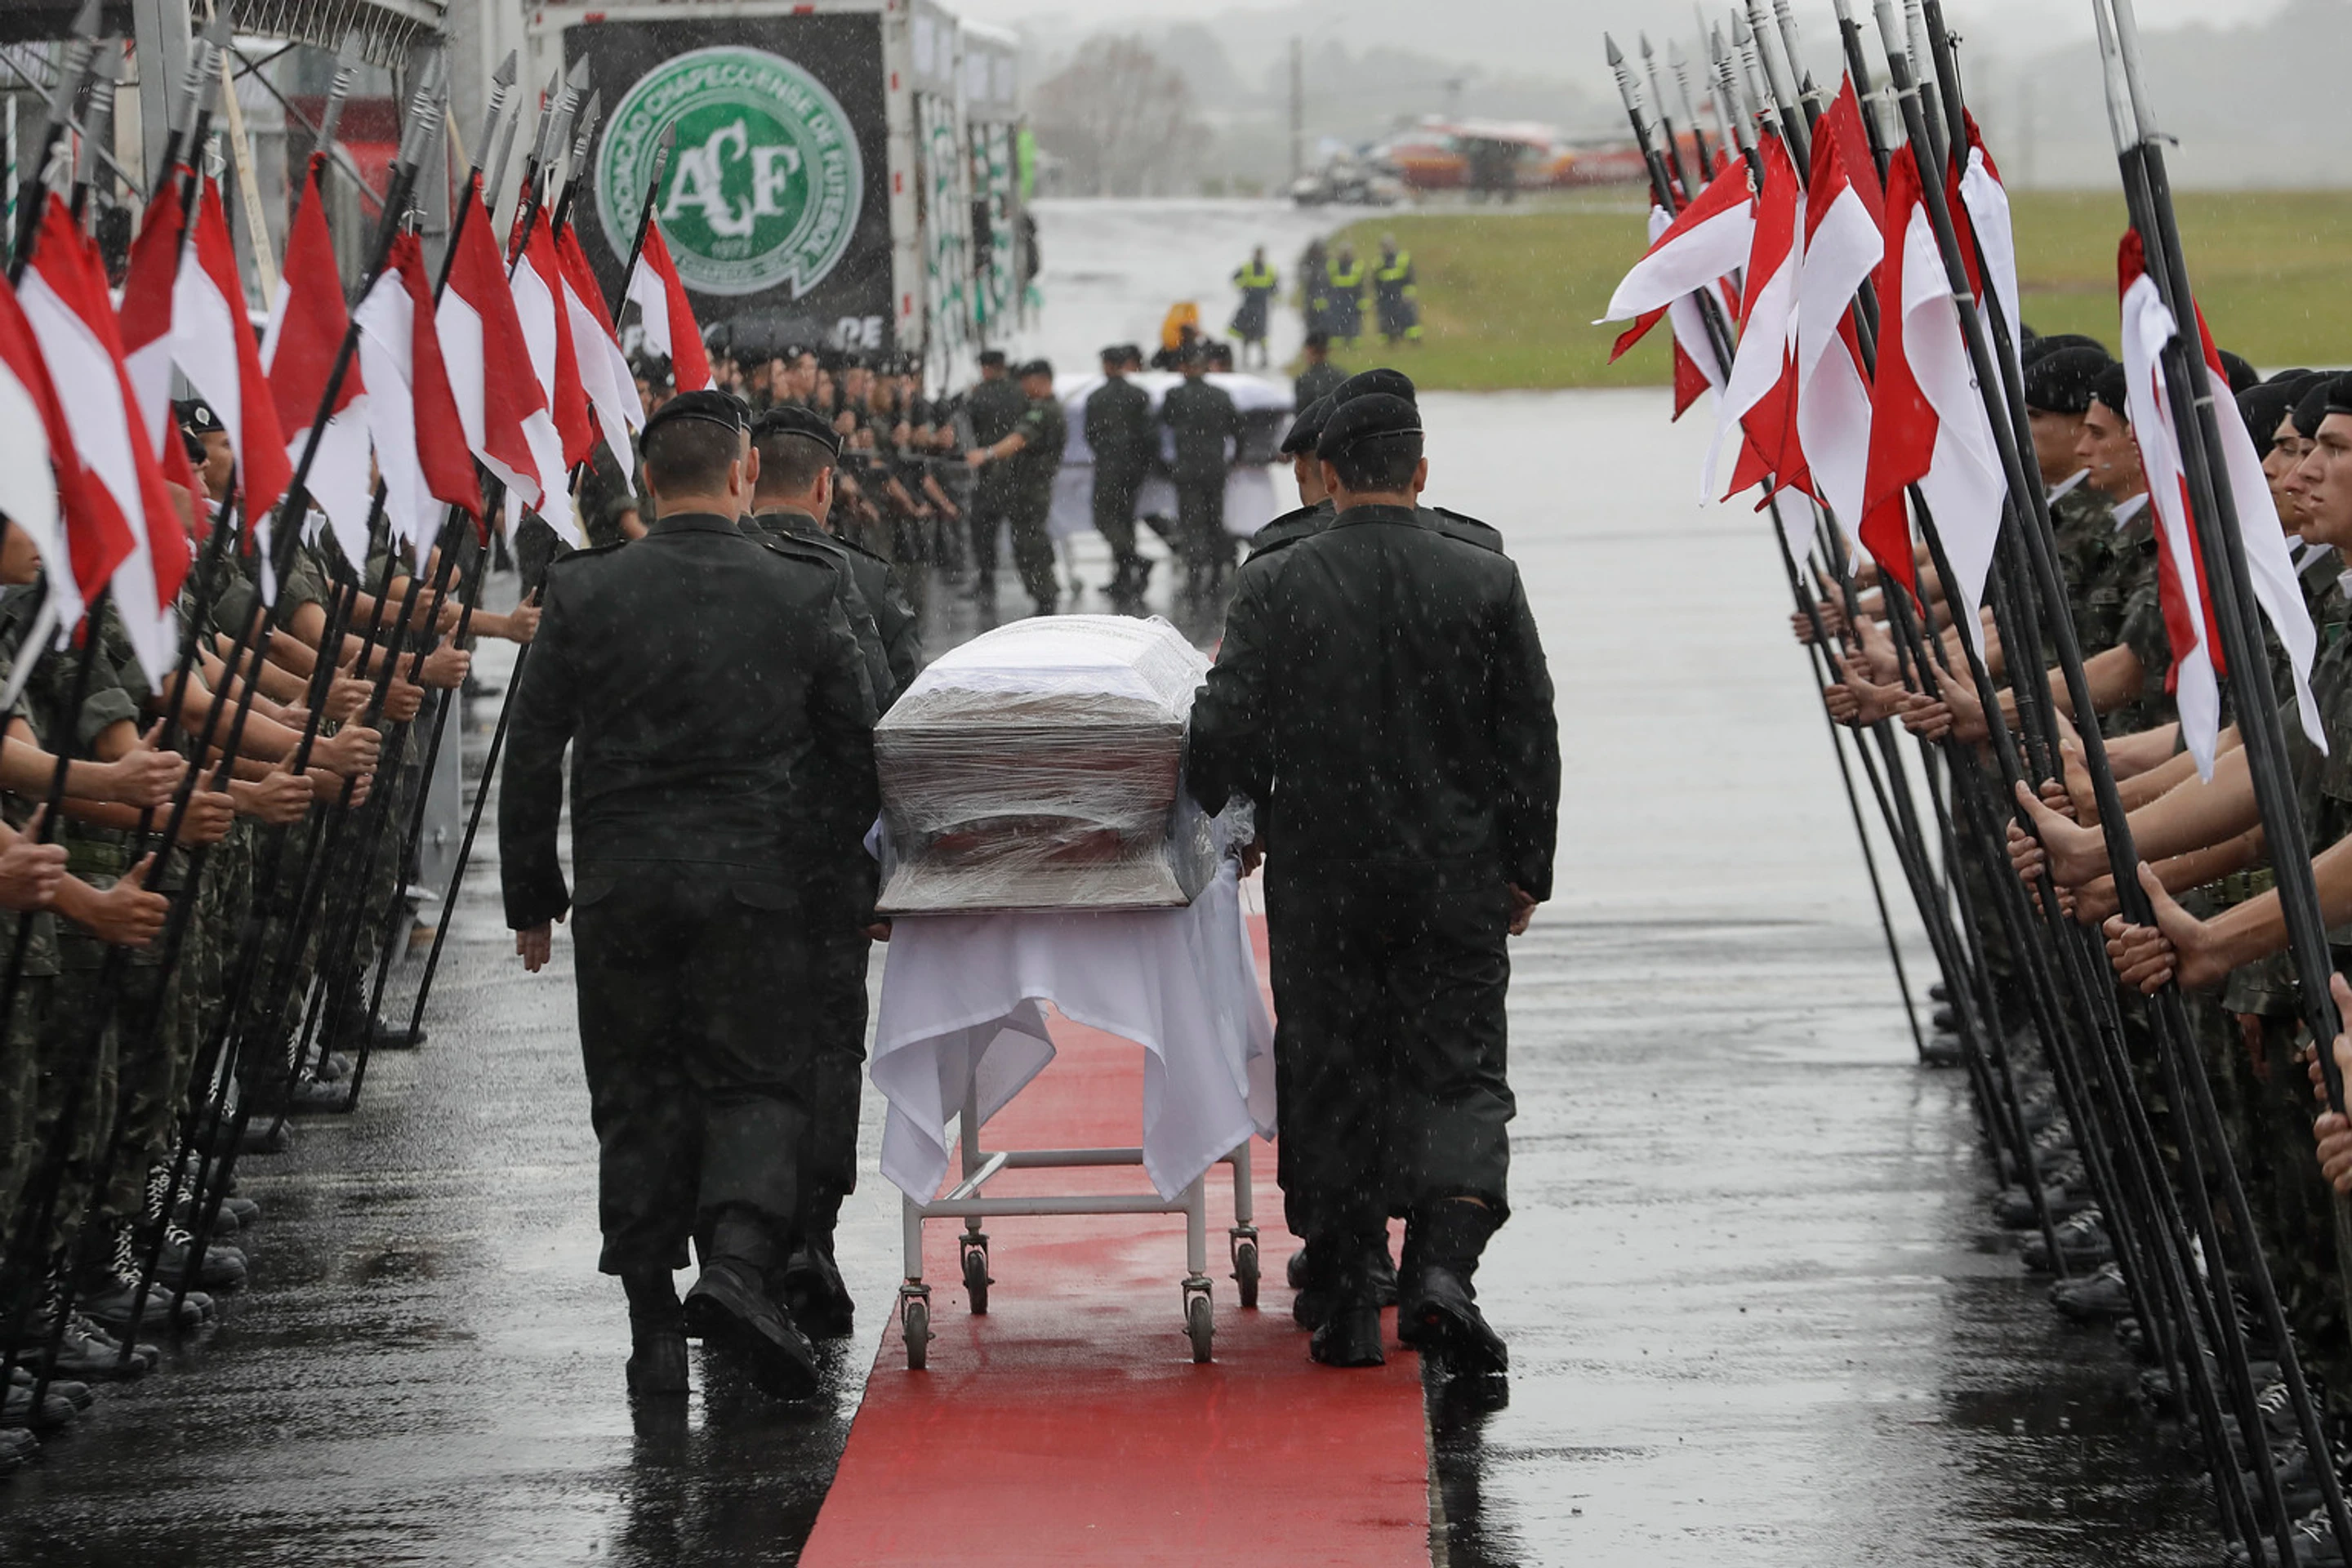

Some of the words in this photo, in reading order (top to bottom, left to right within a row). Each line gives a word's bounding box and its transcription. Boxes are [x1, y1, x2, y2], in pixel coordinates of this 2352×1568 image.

[660, 117, 801, 237] ACF
[807, 114, 841, 145] DE
[800, 149, 846, 257] FUTEBOL
